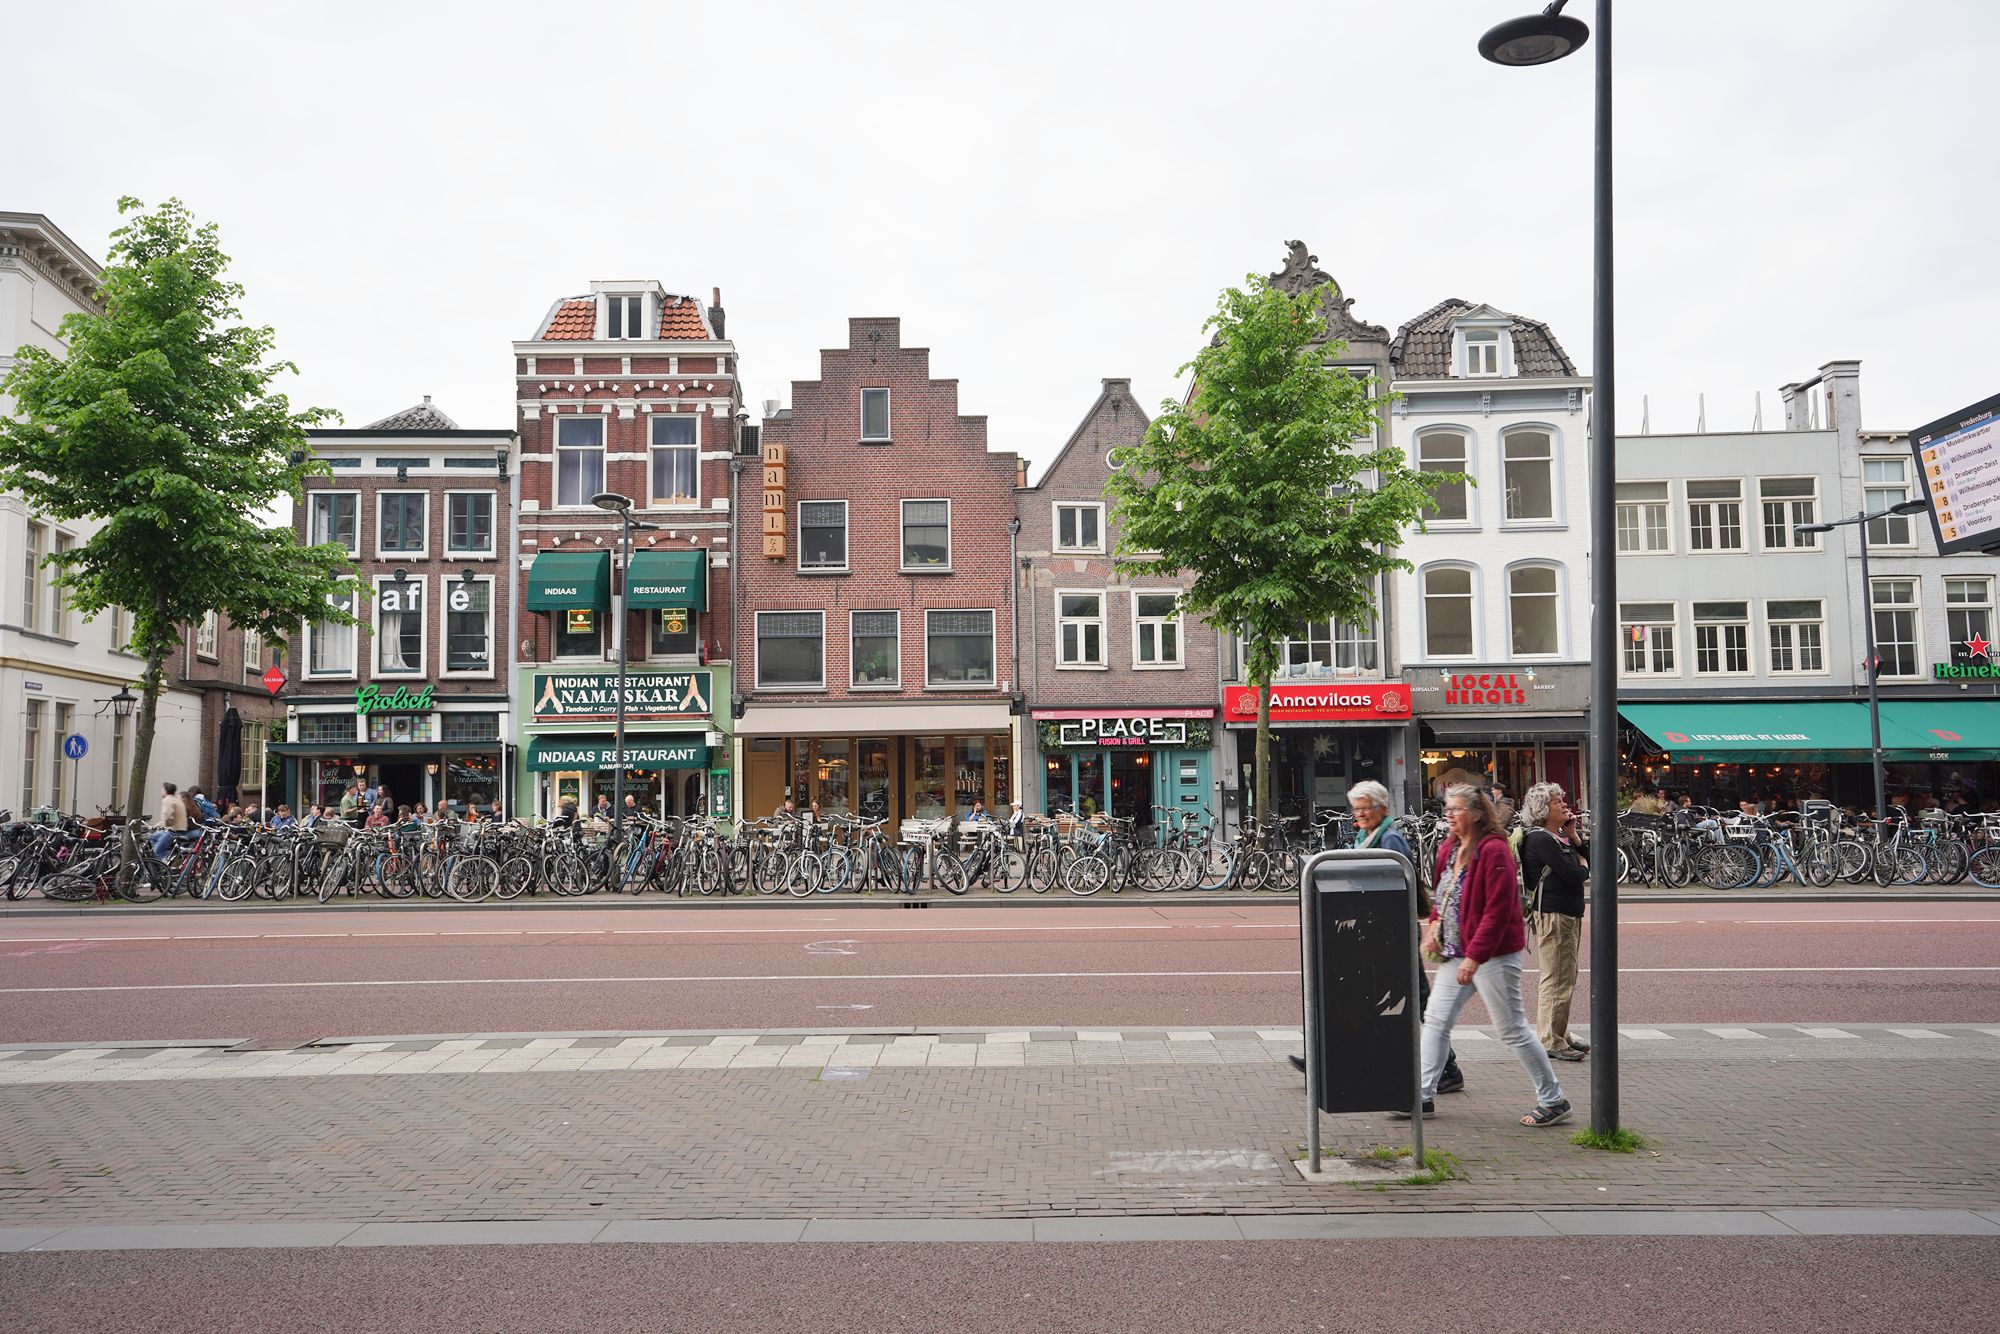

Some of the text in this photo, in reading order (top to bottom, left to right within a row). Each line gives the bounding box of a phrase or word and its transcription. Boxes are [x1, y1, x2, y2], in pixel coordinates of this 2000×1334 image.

[1960, 411, 1993, 428] Vredenburg
[1930, 450, 1937, 460] 2
[1946, 426, 1991, 447] Museumkwartier
[1934, 443, 1993, 475] 8 Wilhelminapark
[1933, 459, 1999, 492] 74 Driebergen-Zeist
[1942, 496, 1949, 506] 8
[1941, 511, 1953, 523] 74
[1950, 515, 1993, 537] 5 Voordorp
[544, 587, 577, 595] INDIAAS
[633, 586, 687, 594] RESTAURANT
[555, 676, 690, 688] INDIAN RESTAURANT
[1451, 673, 1519, 689] LOCAL
[354, 683, 437, 715] Grolsch
[561, 688, 680, 704] NAMASKAR
[1269, 693, 1372, 707] Annavilaas
[1445, 689, 1526, 705] HEROES
[565, 705, 593, 713] Tandoori
[644, 705, 678, 713] Vegetarian
[1184, 709, 1213, 717] PLACE
[1082, 718, 1164, 737] PLACE
[1098, 737, 1146, 746] FUSION & GRILL
[537, 750, 596, 763] INDIAAS
